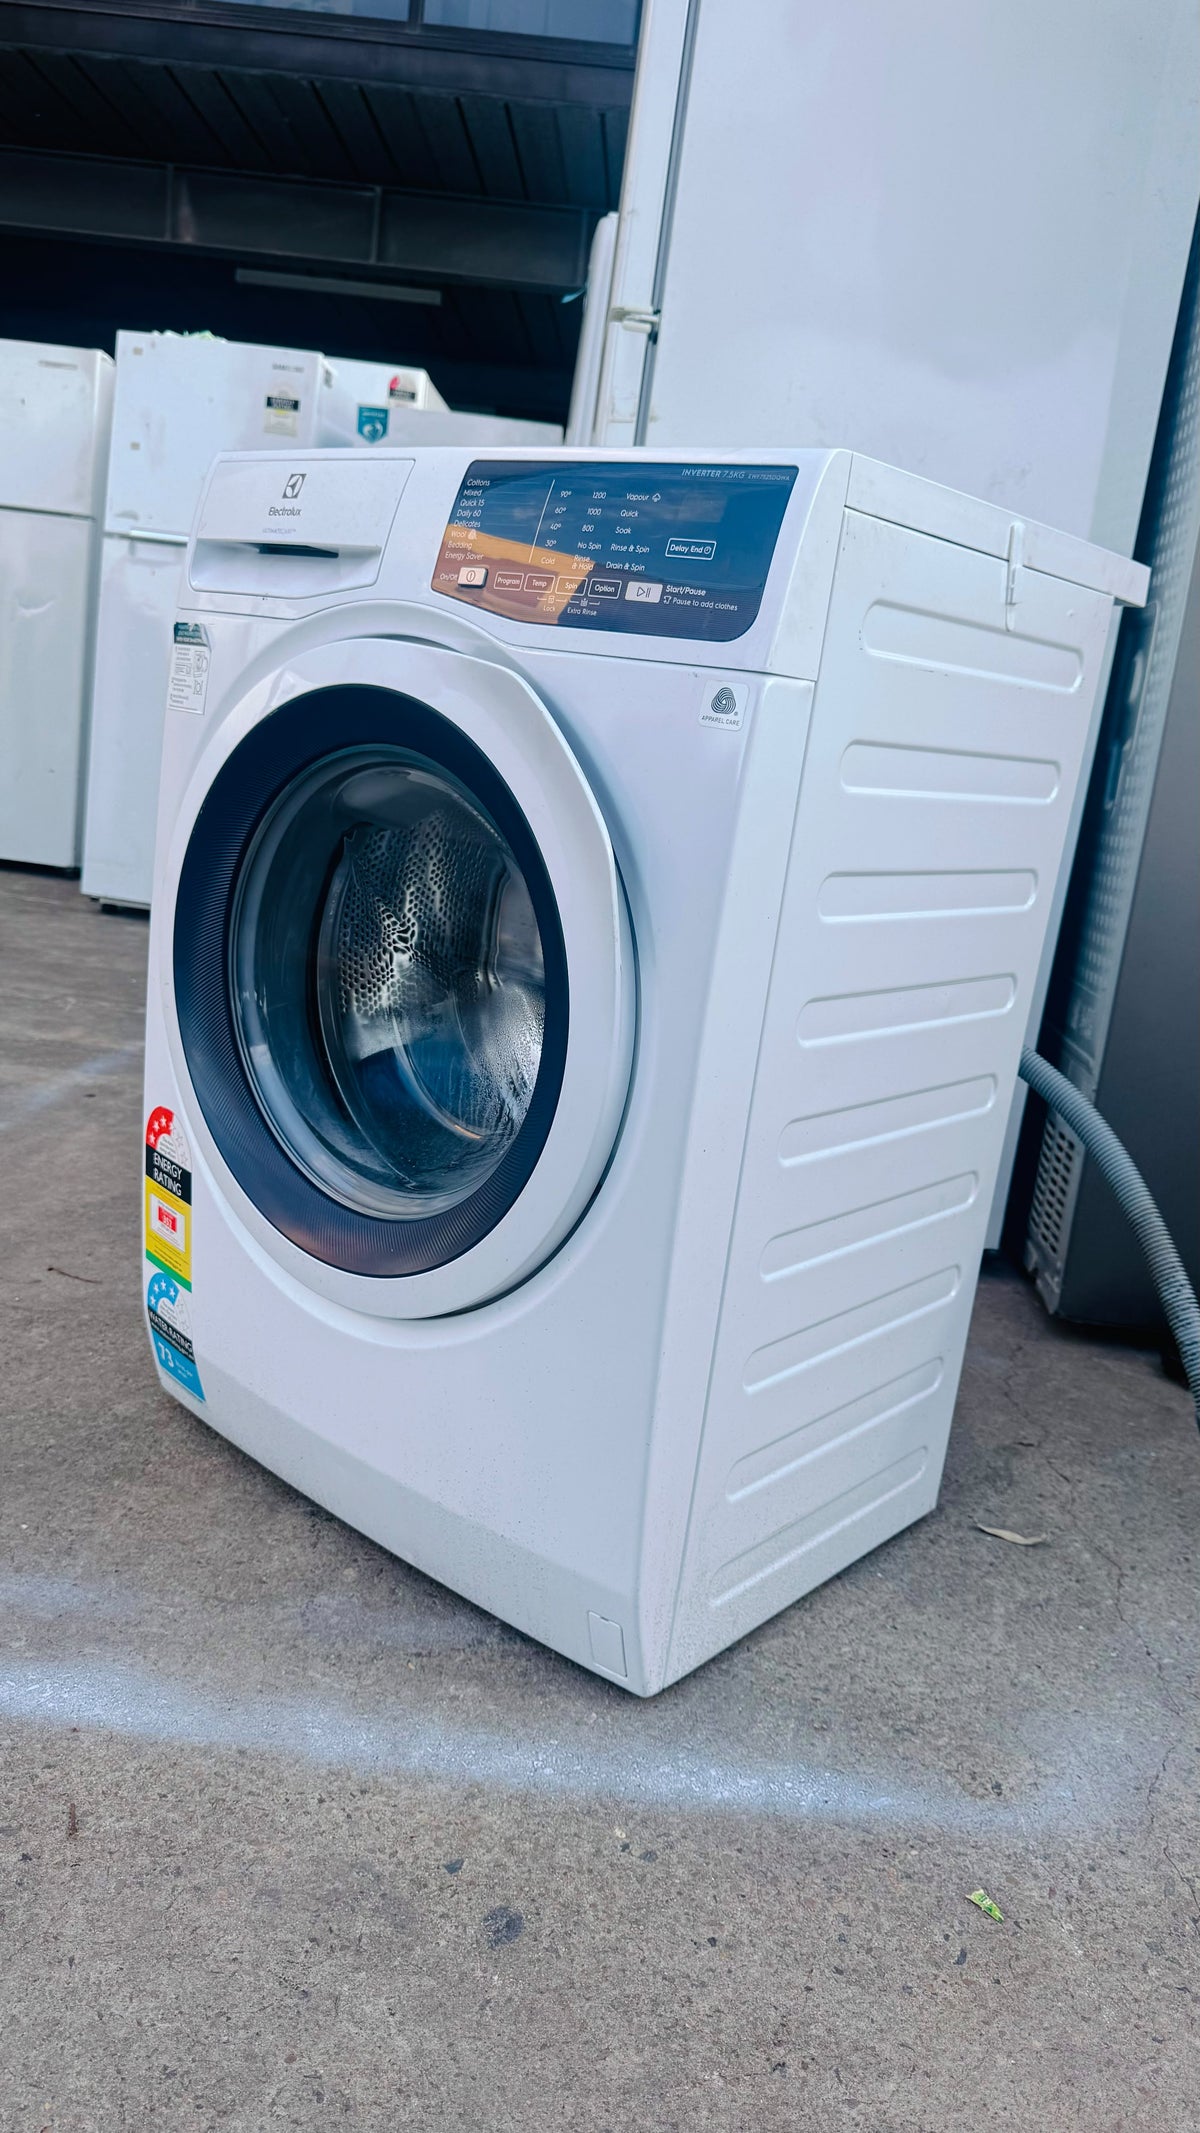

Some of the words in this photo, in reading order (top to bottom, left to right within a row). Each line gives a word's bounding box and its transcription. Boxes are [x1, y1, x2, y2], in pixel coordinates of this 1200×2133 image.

[681, 468, 721, 478] INVERTER
[722, 471, 745, 479] 7.5KG
[592, 491, 606, 499] 1200
[626, 493, 649, 502] Vapour
[460, 499, 477, 507] Quick
[268, 506, 302, 517] Electrolux
[456, 509, 471, 518] Daily
[472, 509, 482, 517] 60
[587, 508, 602, 516] 1000
[620, 509, 639, 518] Quick
[453, 520, 481, 528] Delicates
[581, 524, 595, 533] 800
[451, 530, 467, 538] Wool
[615, 526, 632, 535] Soak
[447, 542, 472, 551] Bedding
[577, 541, 587, 549] No
[588, 542, 602, 551] Spin
[610, 543, 628, 552] Rinse
[628, 545, 634, 553] &
[635, 546, 650, 555] Spin
[670, 544, 690, 554] Delay
[690, 545, 703, 553] End
[445, 552, 465, 561] Energy
[541, 557, 555, 565] Cold
[573, 554, 591, 562] Rinse
[579, 563, 594, 571] Hold
[606, 561, 623, 570] Drain
[623, 563, 630, 571] &
[630, 563, 645, 572] Spin
[440, 573, 458, 581] On/Off
[498, 577, 520, 585] Program
[532, 579, 547, 588] Temp
[565, 582, 578, 590] Spin
[594, 584, 615, 593] Option
[665, 584, 706, 596] Start/Pause
[672, 596, 691, 606] Pause
[692, 599, 700, 607] to
[700, 601, 714, 609] add
[714, 603, 738, 611] clothes
[701, 715, 725, 724] APPAREL
[153, 1152, 182, 1179] ENERGY
[153, 1168, 182, 1196] RATING
[149, 1310, 168, 1332] WATER
[167, 1326, 193, 1352] RATING
[158, 1341, 174, 1368] 73
